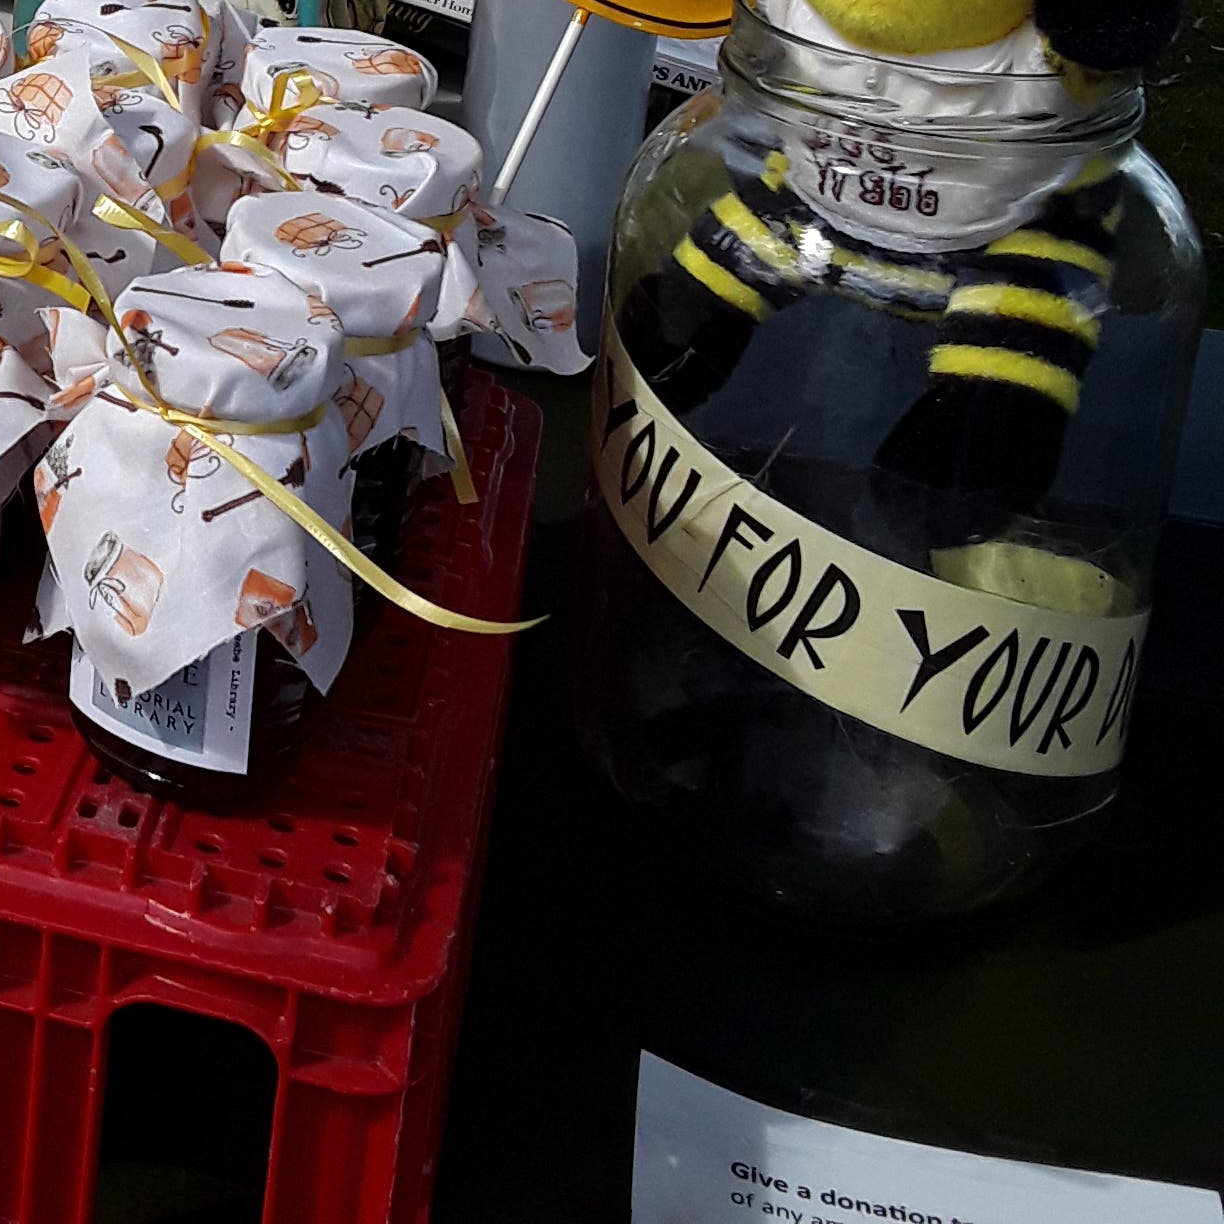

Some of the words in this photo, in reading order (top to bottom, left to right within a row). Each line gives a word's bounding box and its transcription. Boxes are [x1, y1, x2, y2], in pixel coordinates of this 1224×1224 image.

[600, 355, 702, 545] YOU
[697, 503, 861, 671] FOR
[895, 608, 1101, 755] YOUR
[226, 669, 241, 719] Library
[731, 1161, 789, 1193] Give
[797, 1185, 811, 1200] a
[820, 1189, 942, 1224] donation
[731, 1191, 755, 1208] of
[762, 1202, 803, 1223] any
